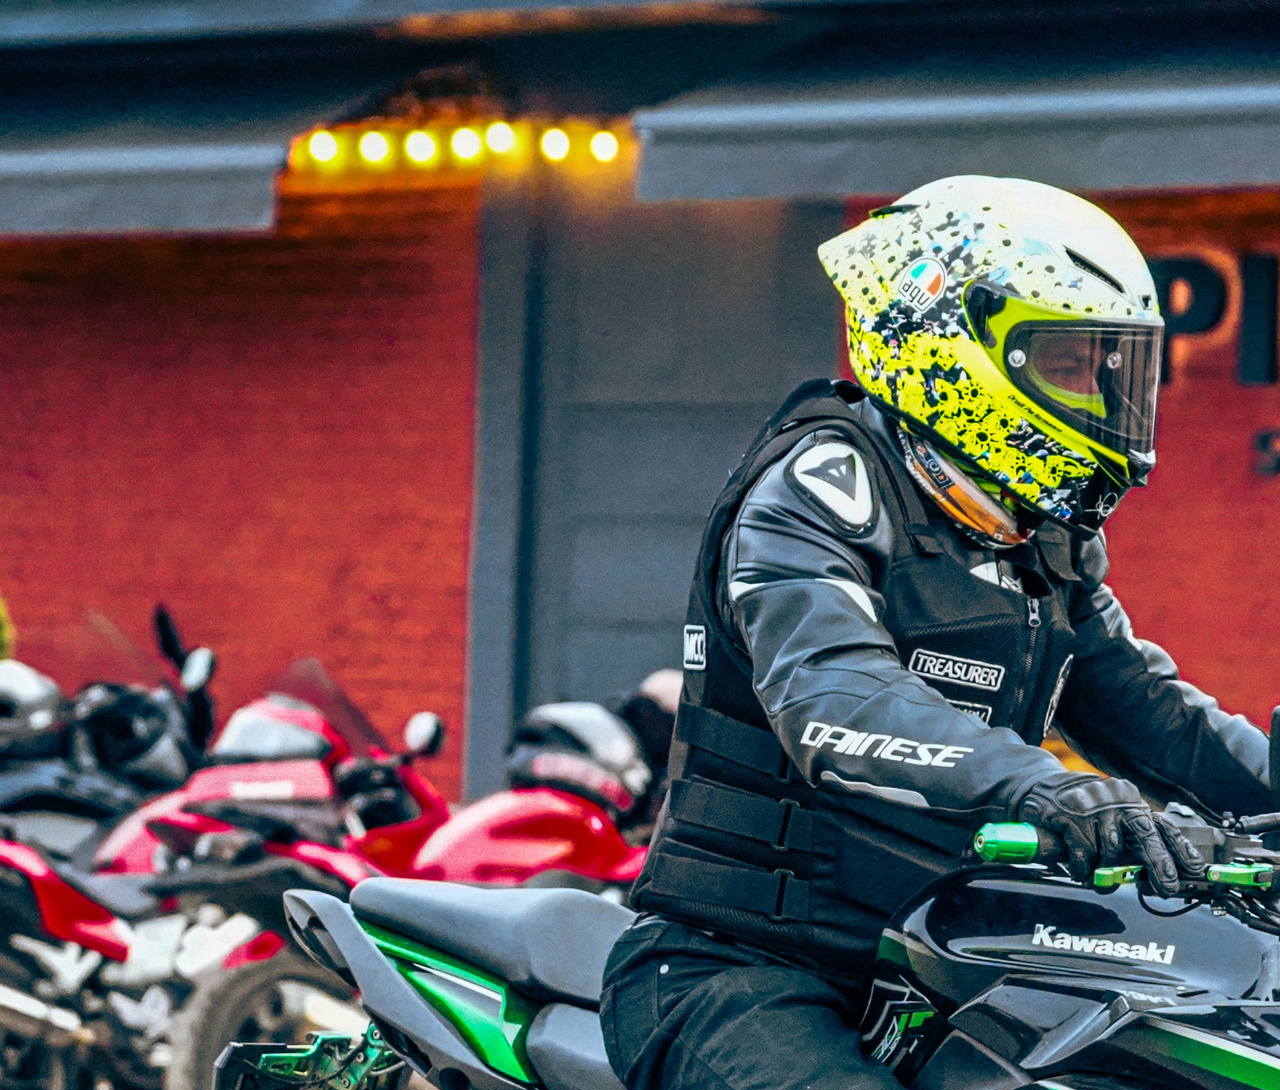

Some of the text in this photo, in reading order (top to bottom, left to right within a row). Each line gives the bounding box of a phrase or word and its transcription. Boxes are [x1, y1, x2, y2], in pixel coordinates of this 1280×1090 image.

[916, 653, 999, 687] TREASURER
[800, 721, 974, 768] DAINESE
[1031, 923, 1175, 965] Kawasaki
